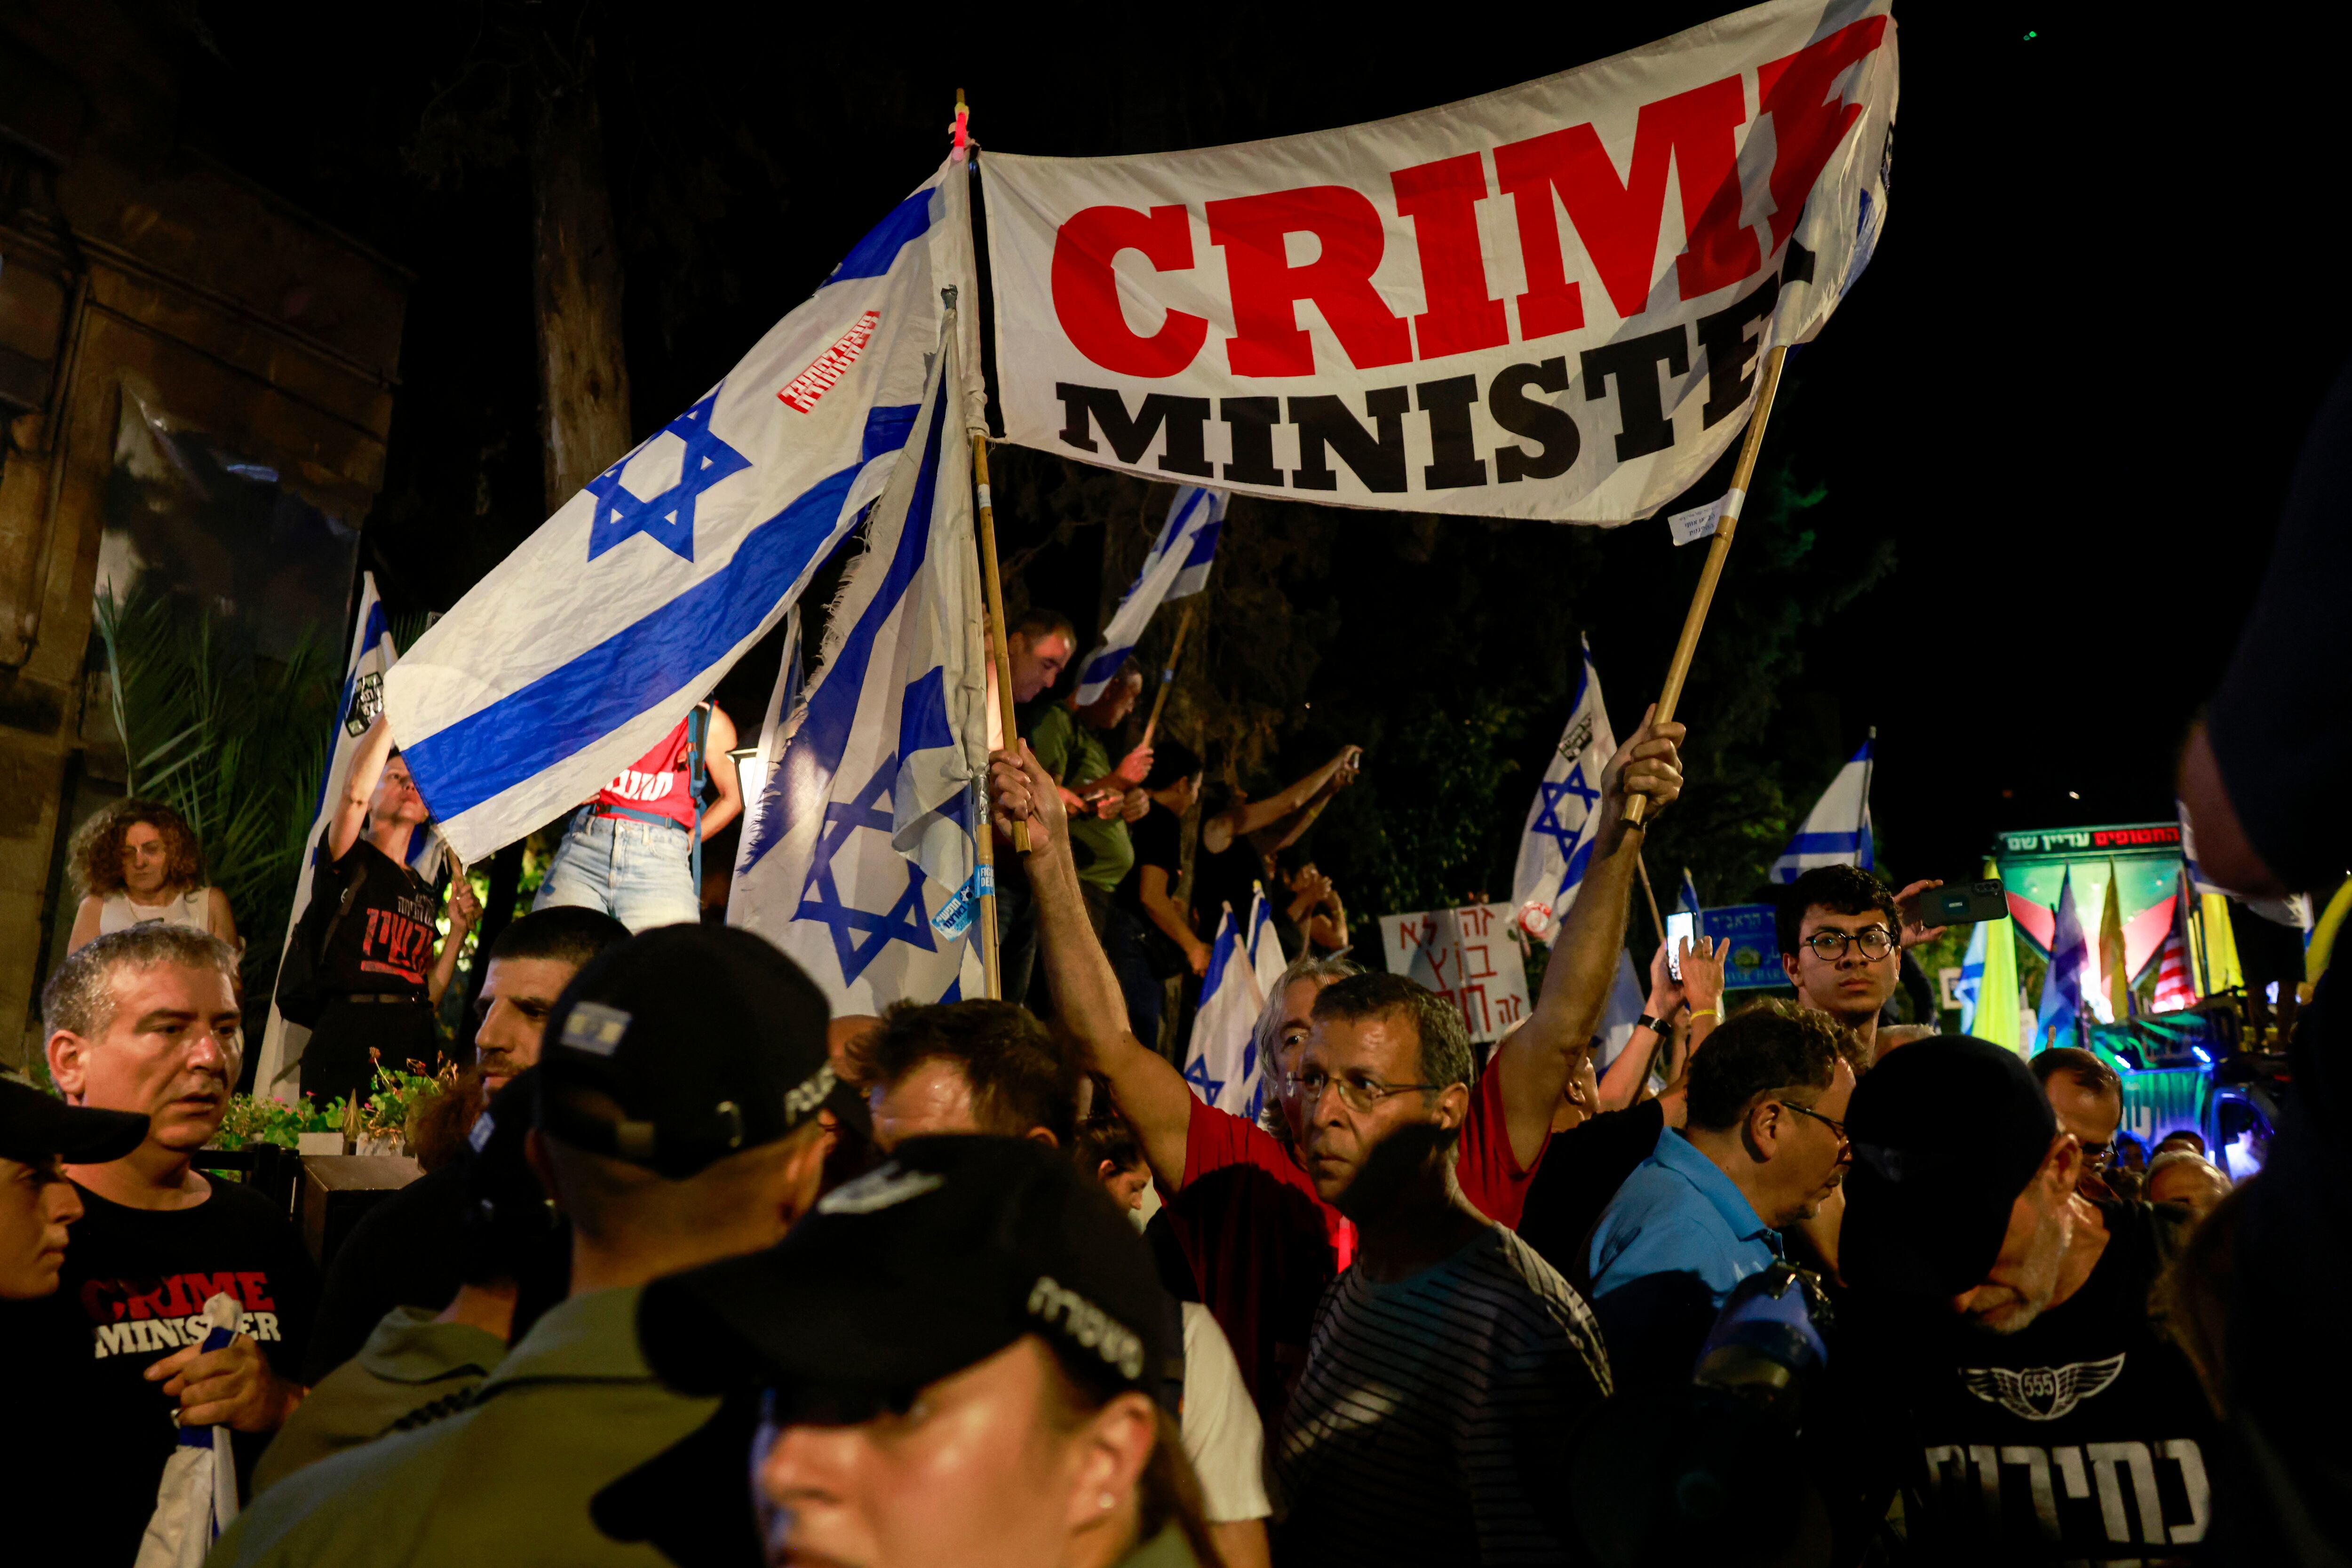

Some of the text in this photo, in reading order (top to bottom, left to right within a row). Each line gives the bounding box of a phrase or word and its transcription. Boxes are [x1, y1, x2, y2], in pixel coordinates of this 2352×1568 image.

[781, 349, 839, 399] להתנגד
[1055, 236, 1814, 493] MINISTE
[2007, 827, 2180, 852] החטופים עדיין שם
[1400, 907, 1495, 950] זה לא
[1425, 941, 1498, 989] בוץ
[1495, 994, 1522, 1025] זה
[81, 1272, 276, 1322] CRIME
[95, 1312, 281, 1359] MINISER
[2024, 1373, 2054, 1398] 555
